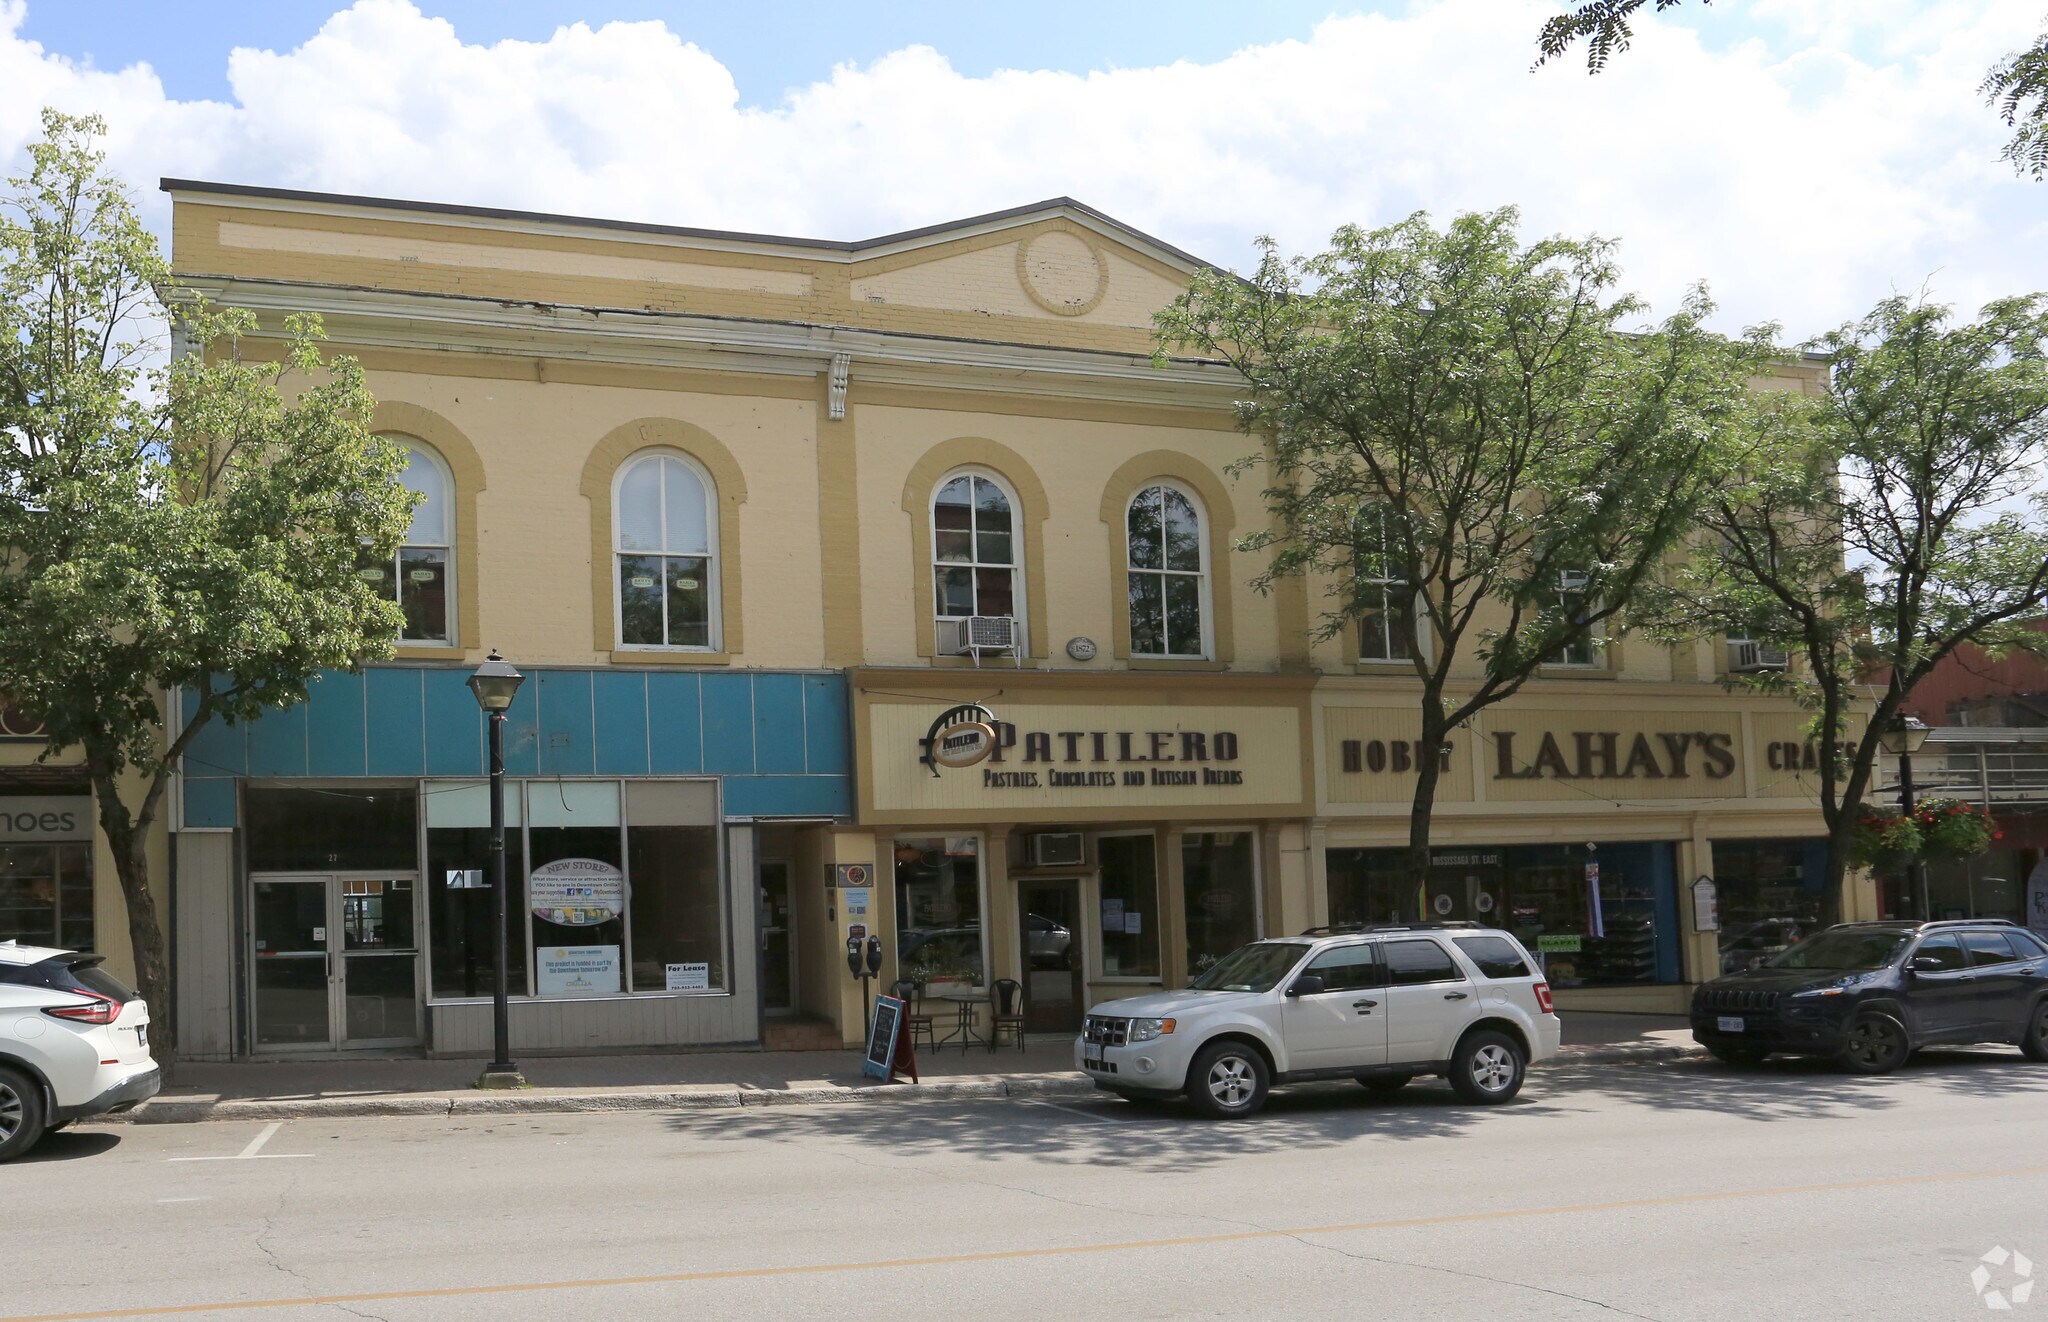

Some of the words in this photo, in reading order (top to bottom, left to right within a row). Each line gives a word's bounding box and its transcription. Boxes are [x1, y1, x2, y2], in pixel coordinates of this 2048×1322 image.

[988, 721, 1239, 762] PATILERO
[1493, 731, 1736, 780] LAHAY'S
[1767, 741, 1858, 770] CRAS
[984, 768, 1042, 788] PASTRIES,
[1048, 768, 1116, 786] CHOCOLATES
[1123, 769, 1146, 786] AND
[1151, 767, 1197, 786] ARTISAN
[546, 861, 571, 873] NEW
[572, 861, 610, 873] STORE?
[1471, 855, 1480, 865] ST.
[1482, 854, 1498, 865] EAST
